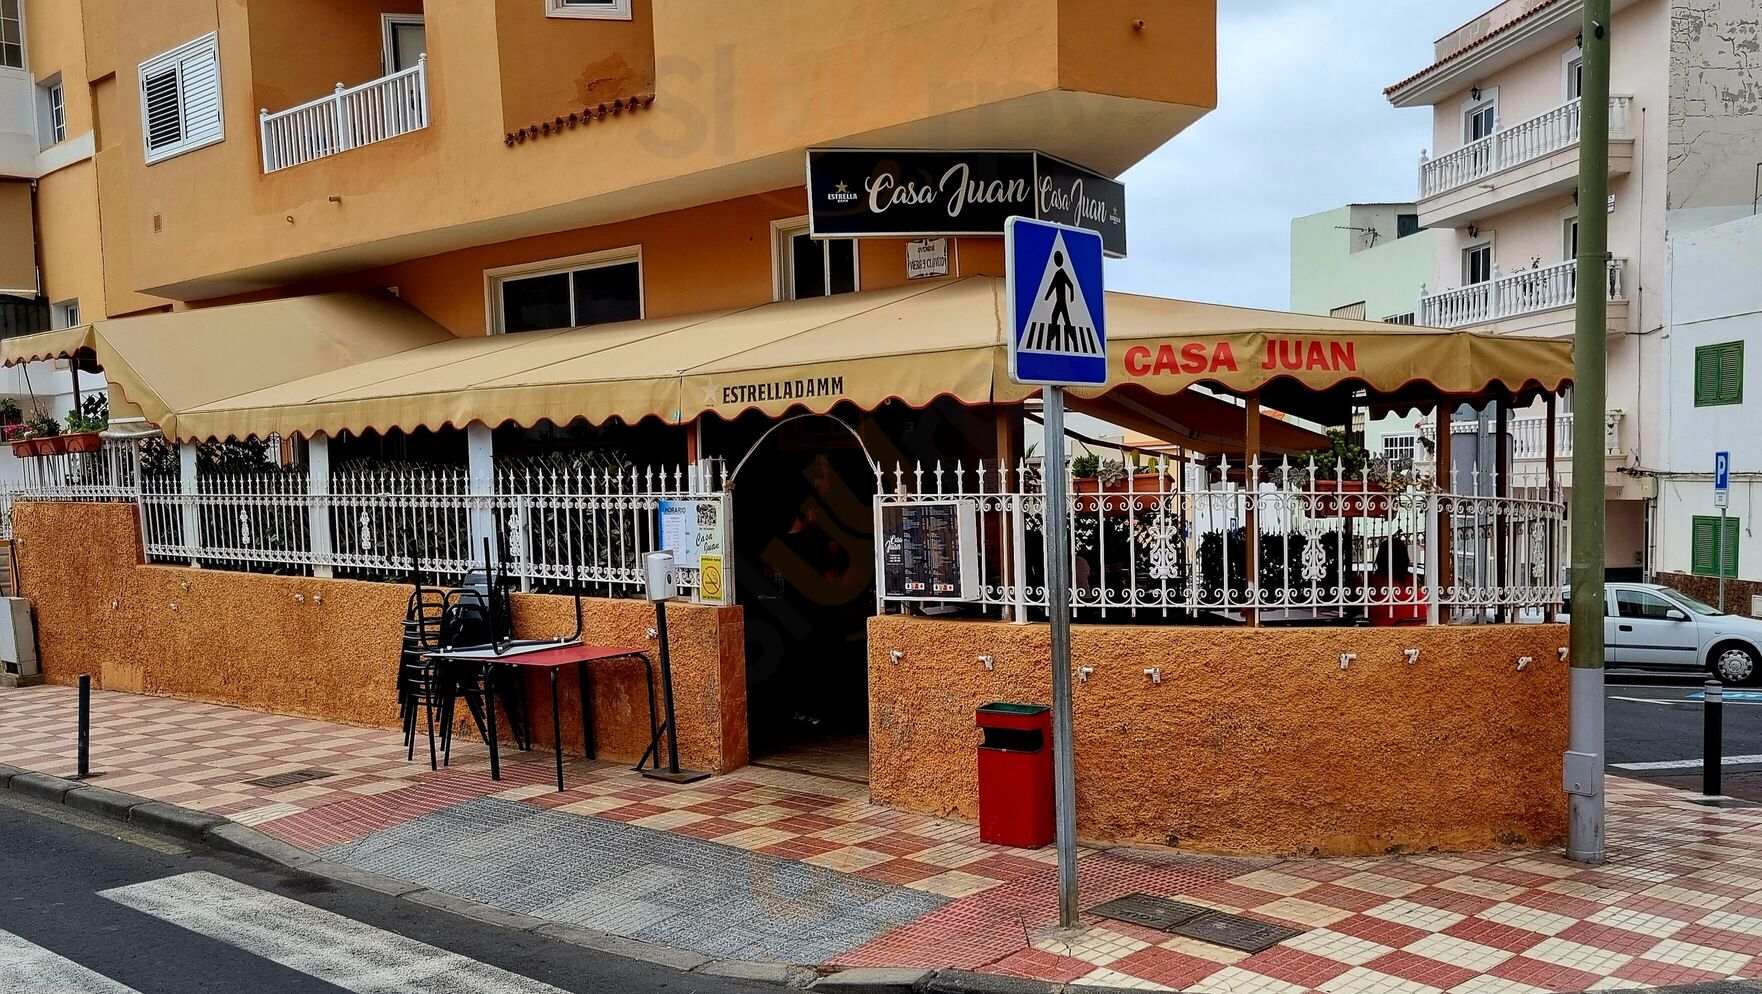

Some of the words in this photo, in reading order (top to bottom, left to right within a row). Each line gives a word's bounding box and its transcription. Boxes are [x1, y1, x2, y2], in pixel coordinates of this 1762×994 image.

[865, 173, 937, 213] Casa
[939, 163, 1030, 217] Juan
[1039, 176, 1070, 213] Casa
[1071, 178, 1108, 227] Juan
[1124, 342, 1238, 376] CASA
[1261, 339, 1357, 371] JUAN
[1717, 455, 1726, 484] P
[695, 532, 712, 546] Casa
[704, 542, 720, 554] Juan
